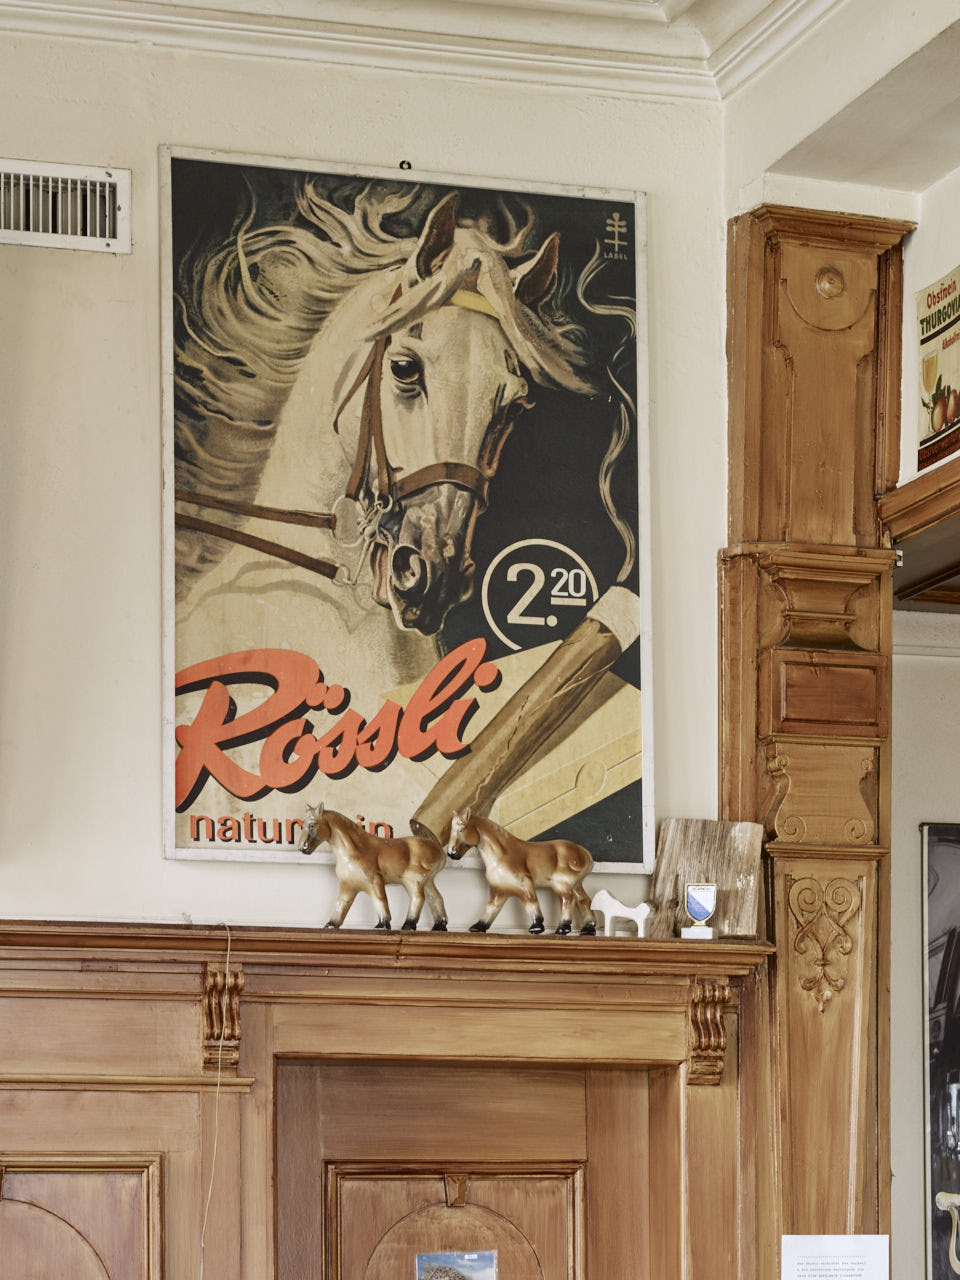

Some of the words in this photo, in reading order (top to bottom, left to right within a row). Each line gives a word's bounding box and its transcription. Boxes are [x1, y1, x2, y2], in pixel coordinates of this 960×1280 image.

[604, 251, 628, 261] LABEL
[927, 278, 957, 309] Obstwein
[175, 637, 502, 813] Rössli
